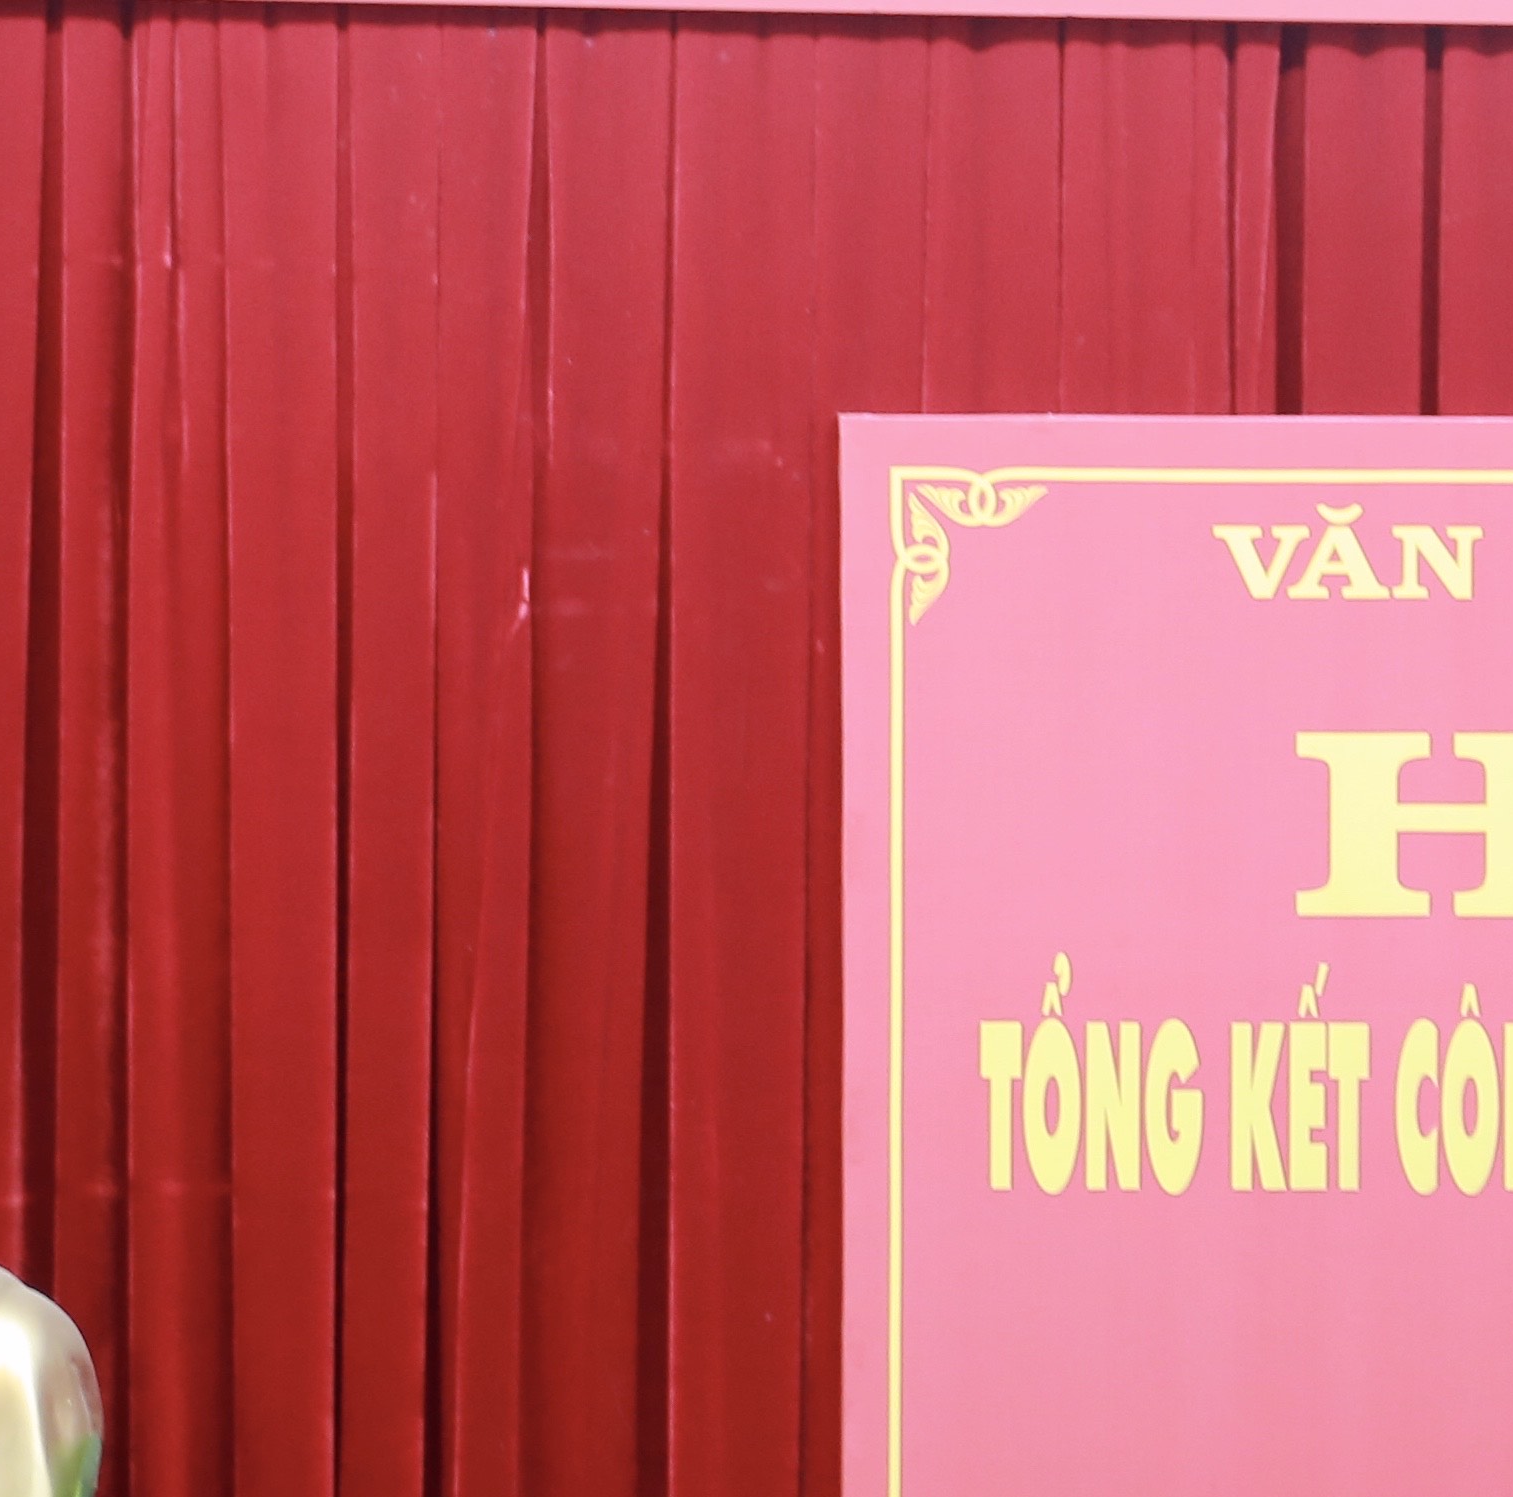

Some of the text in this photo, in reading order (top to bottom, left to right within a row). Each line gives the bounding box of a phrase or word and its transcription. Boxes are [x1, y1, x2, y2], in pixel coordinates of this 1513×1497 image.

[1211, 501, 1484, 601] VĂN
[979, 951, 1204, 1196] TỔNG
[1230, 961, 1370, 1192] KẾT
